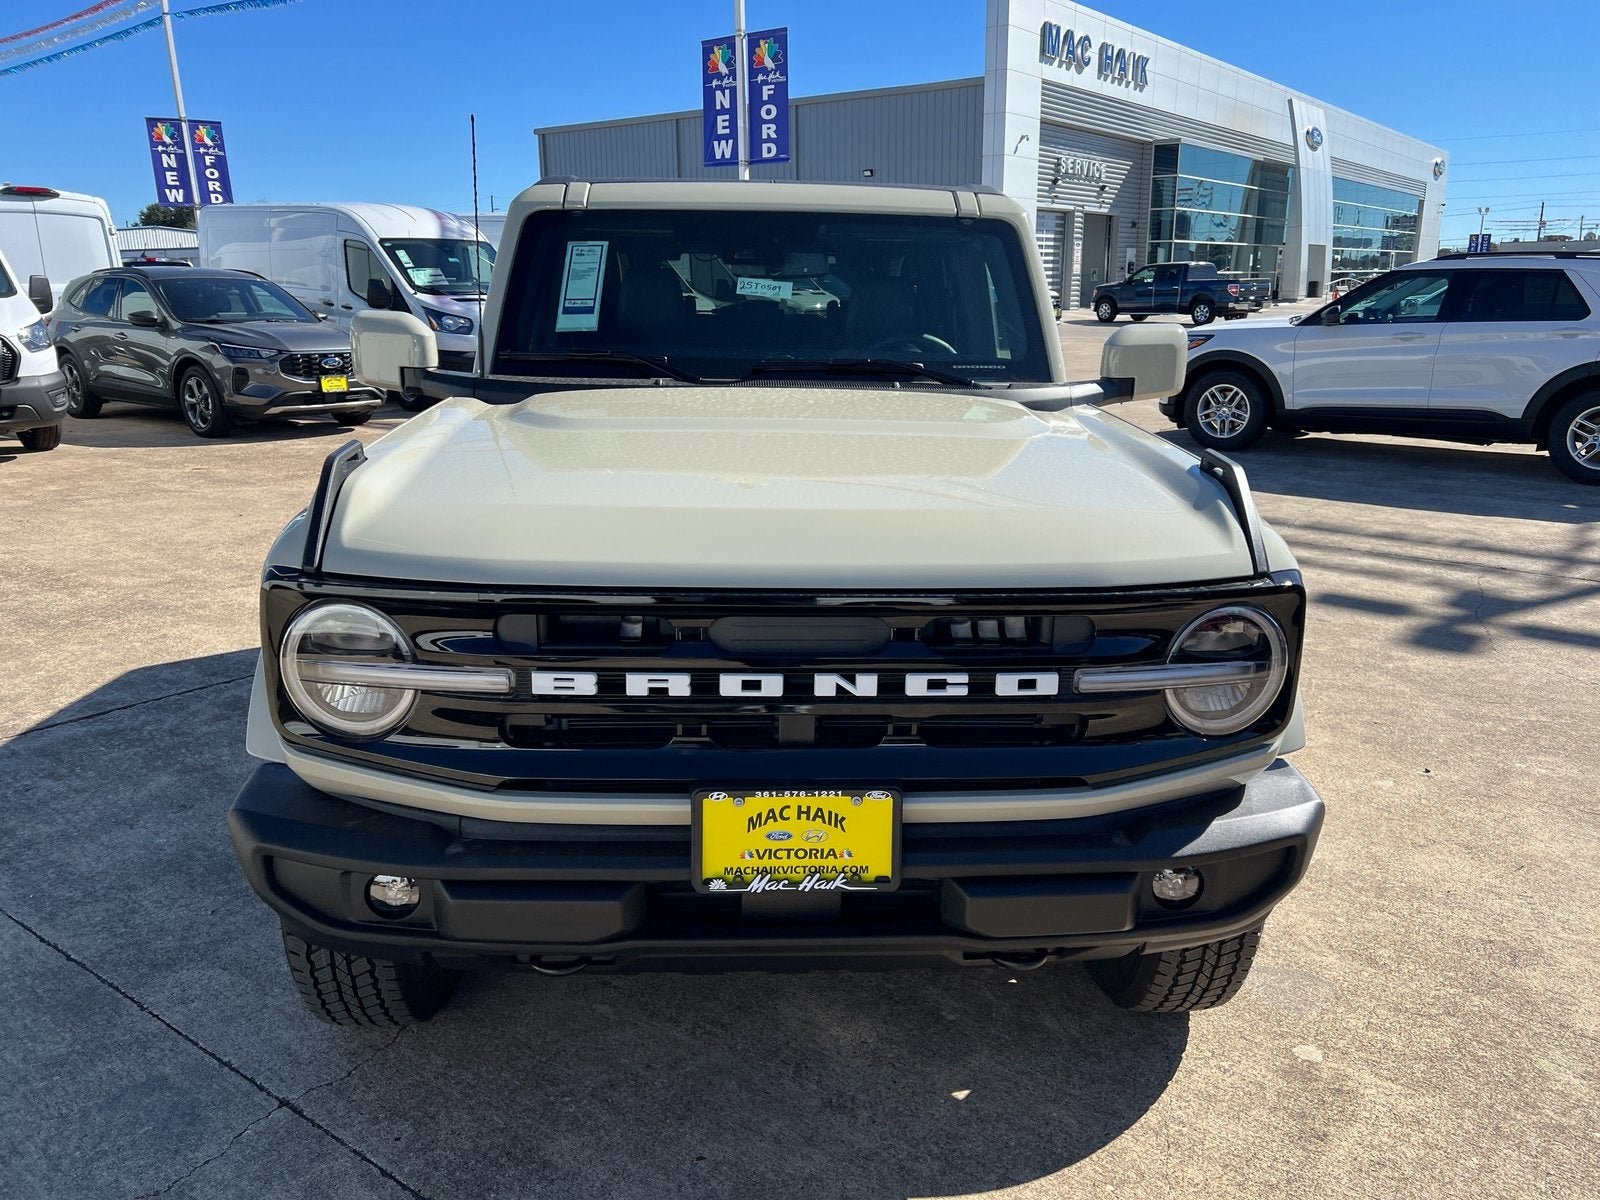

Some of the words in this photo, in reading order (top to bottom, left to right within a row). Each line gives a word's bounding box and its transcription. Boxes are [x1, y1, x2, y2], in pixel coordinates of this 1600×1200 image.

[1040, 21, 1092, 69] MAC
[1099, 42, 1149, 86] HAIK
[713, 89, 733, 160] NEW
[760, 84, 777, 158] FORD
[161, 153, 184, 203] NEW
[1060, 157, 1107, 178] SERVICE
[204, 155, 224, 204] FORD
[531, 671, 1059, 697] BRONCO
[755, 790, 842, 798] 361-576-1221
[868, 791, 890, 799] Ford
[747, 805, 791, 833] MAC
[796, 805, 847, 833] HAIK
[767, 831, 791, 841] Ford
[755, 848, 838, 860] VICTORIA
[723, 865, 869, 876] MACHAIKVICTORIA.COM
[747, 873, 797, 893] Mac
[798, 873, 854, 892] Haik
